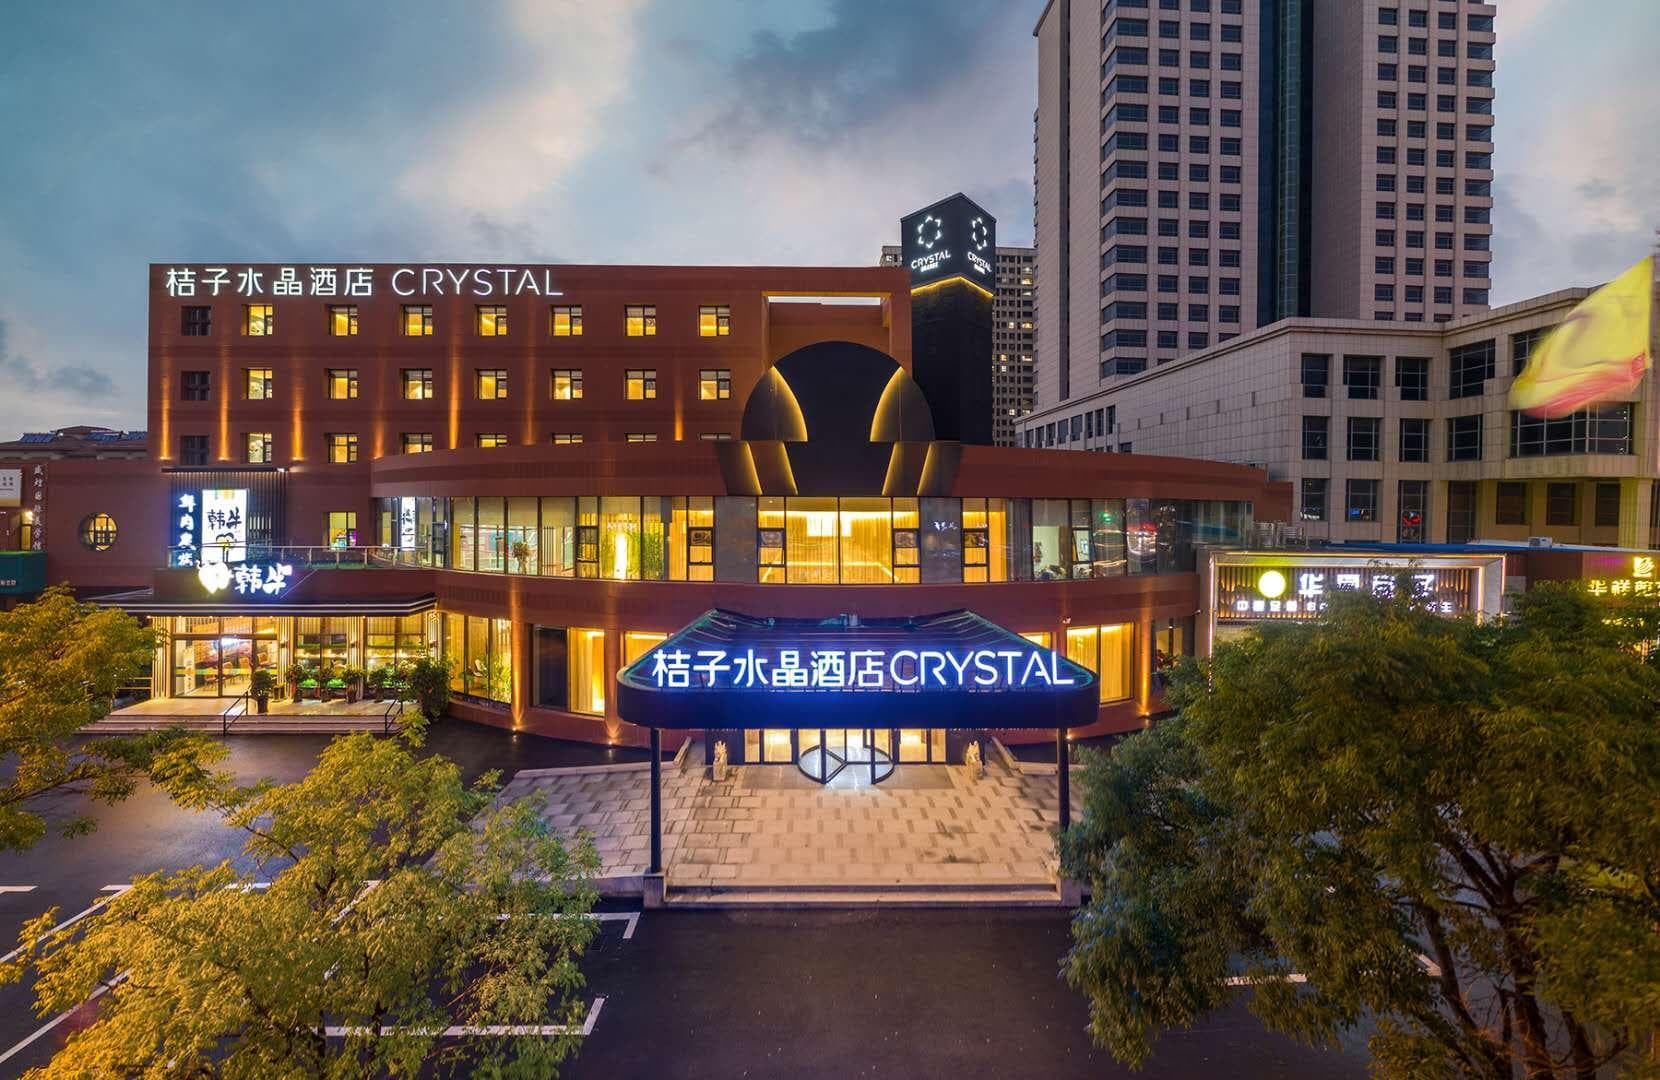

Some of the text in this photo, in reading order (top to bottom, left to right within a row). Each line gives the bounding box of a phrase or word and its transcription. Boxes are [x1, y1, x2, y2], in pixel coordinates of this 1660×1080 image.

[911, 250, 951, 269] CRYSTAL
[166, 267, 563, 297] 桔子水晶酒店 CRYSTAL
[233, 563, 287, 596] 韩牛
[1587, 579, 1660, 597] 华祥苑
[652, 649, 1075, 689] 桔子水晶酒店 CRYSTAL
